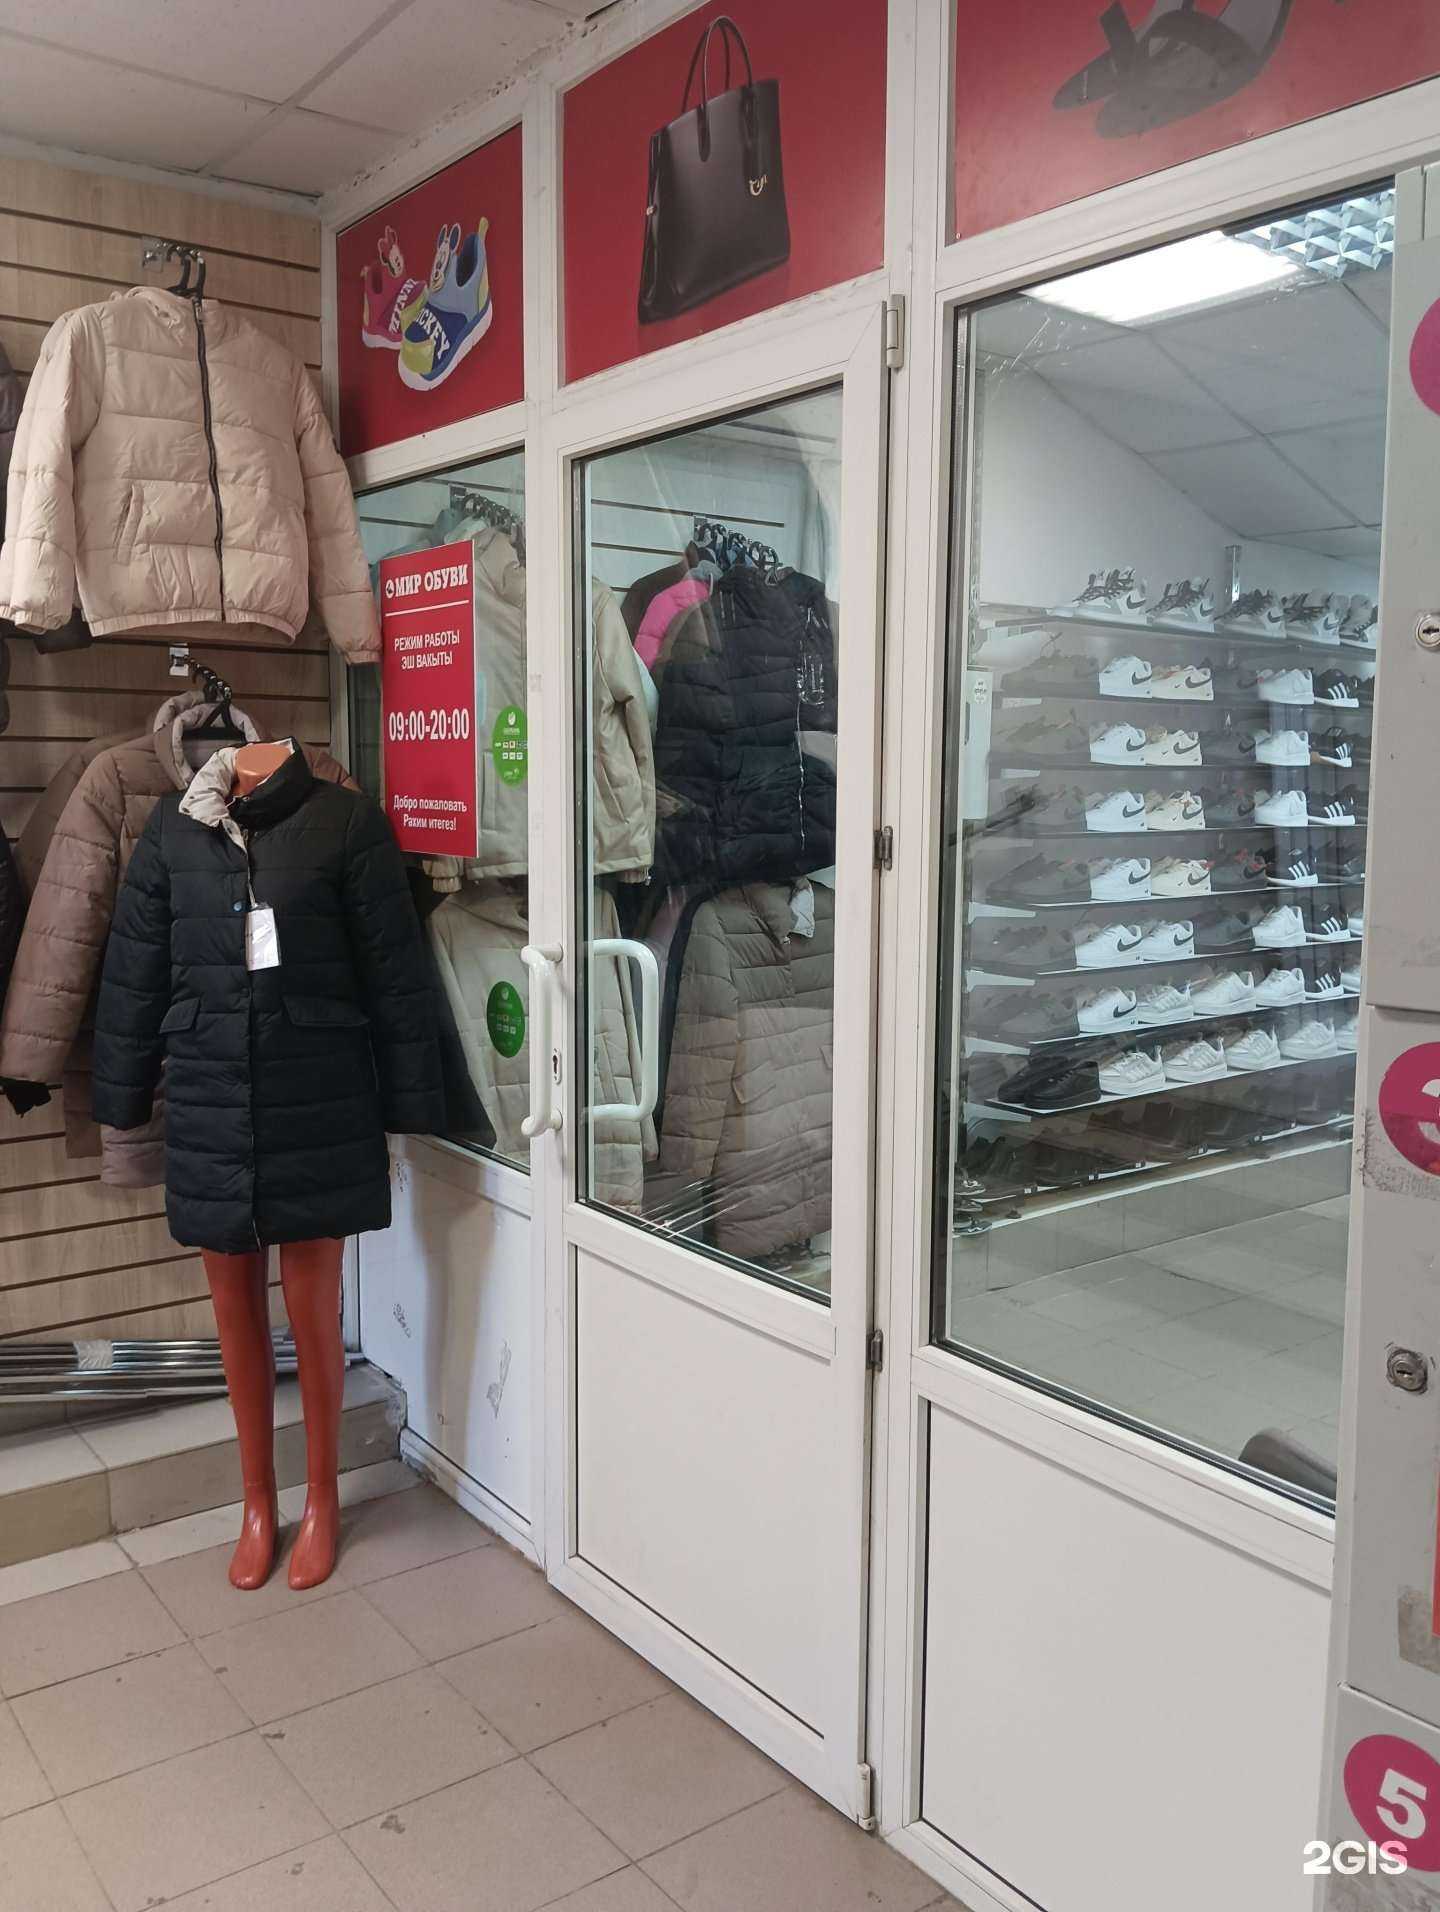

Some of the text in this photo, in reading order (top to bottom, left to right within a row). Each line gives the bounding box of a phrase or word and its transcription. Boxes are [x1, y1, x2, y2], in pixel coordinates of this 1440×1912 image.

[395, 564, 468, 597] МИР ОБУВИ
[394, 629, 460, 652] РЕЖИМ РАБОТЫ
[401, 651, 453, 669] ЭШ ВАКЫТЫ
[389, 708, 470, 741] 09:00-20:00
[393, 795, 467, 812] Добро пожаловать
[1376, 1768, 1427, 1839] 5
